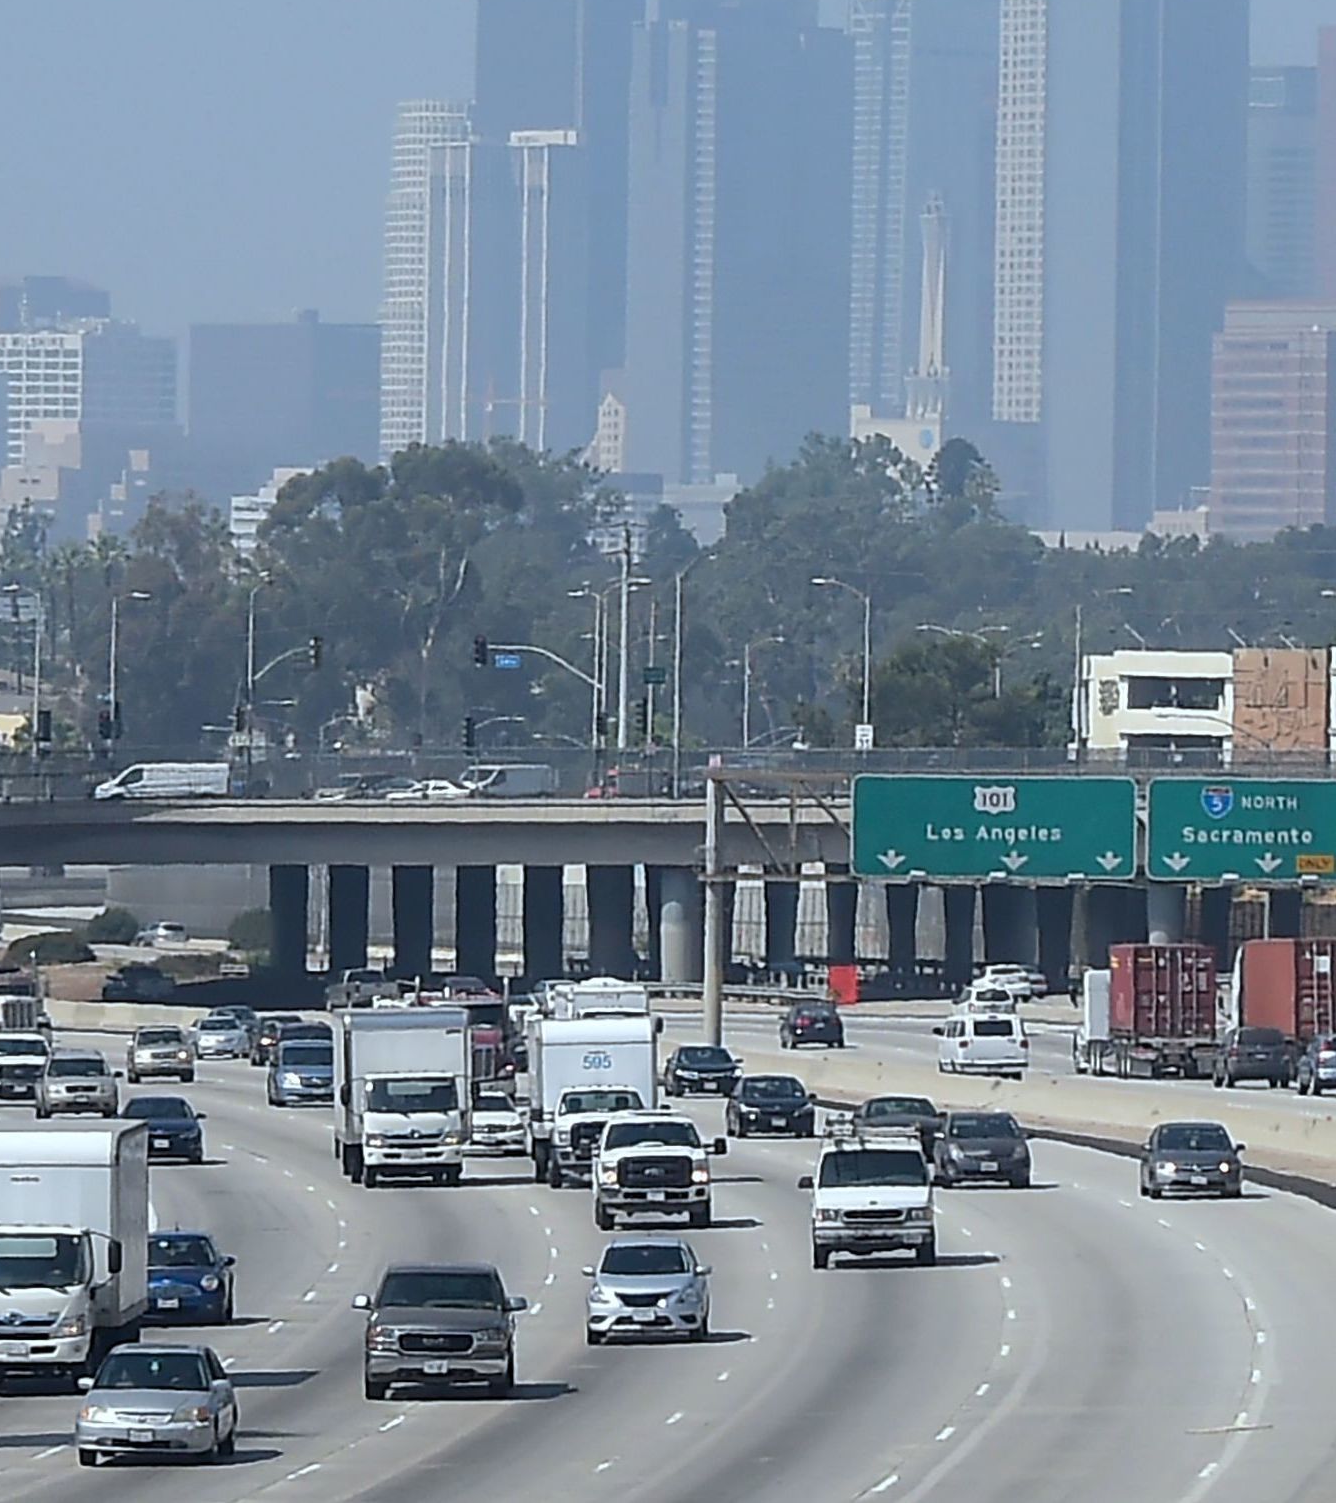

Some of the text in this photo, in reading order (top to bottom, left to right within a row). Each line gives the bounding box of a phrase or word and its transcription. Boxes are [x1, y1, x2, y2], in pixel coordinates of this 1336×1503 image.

[982, 792, 1009, 809] 101
[1211, 796, 1298, 812] 5 NORTH
[926, 823, 1062, 845] Los Angeles
[1182, 827, 1313, 845] Sacramento
[1298, 857, 1332, 870] ONLY
